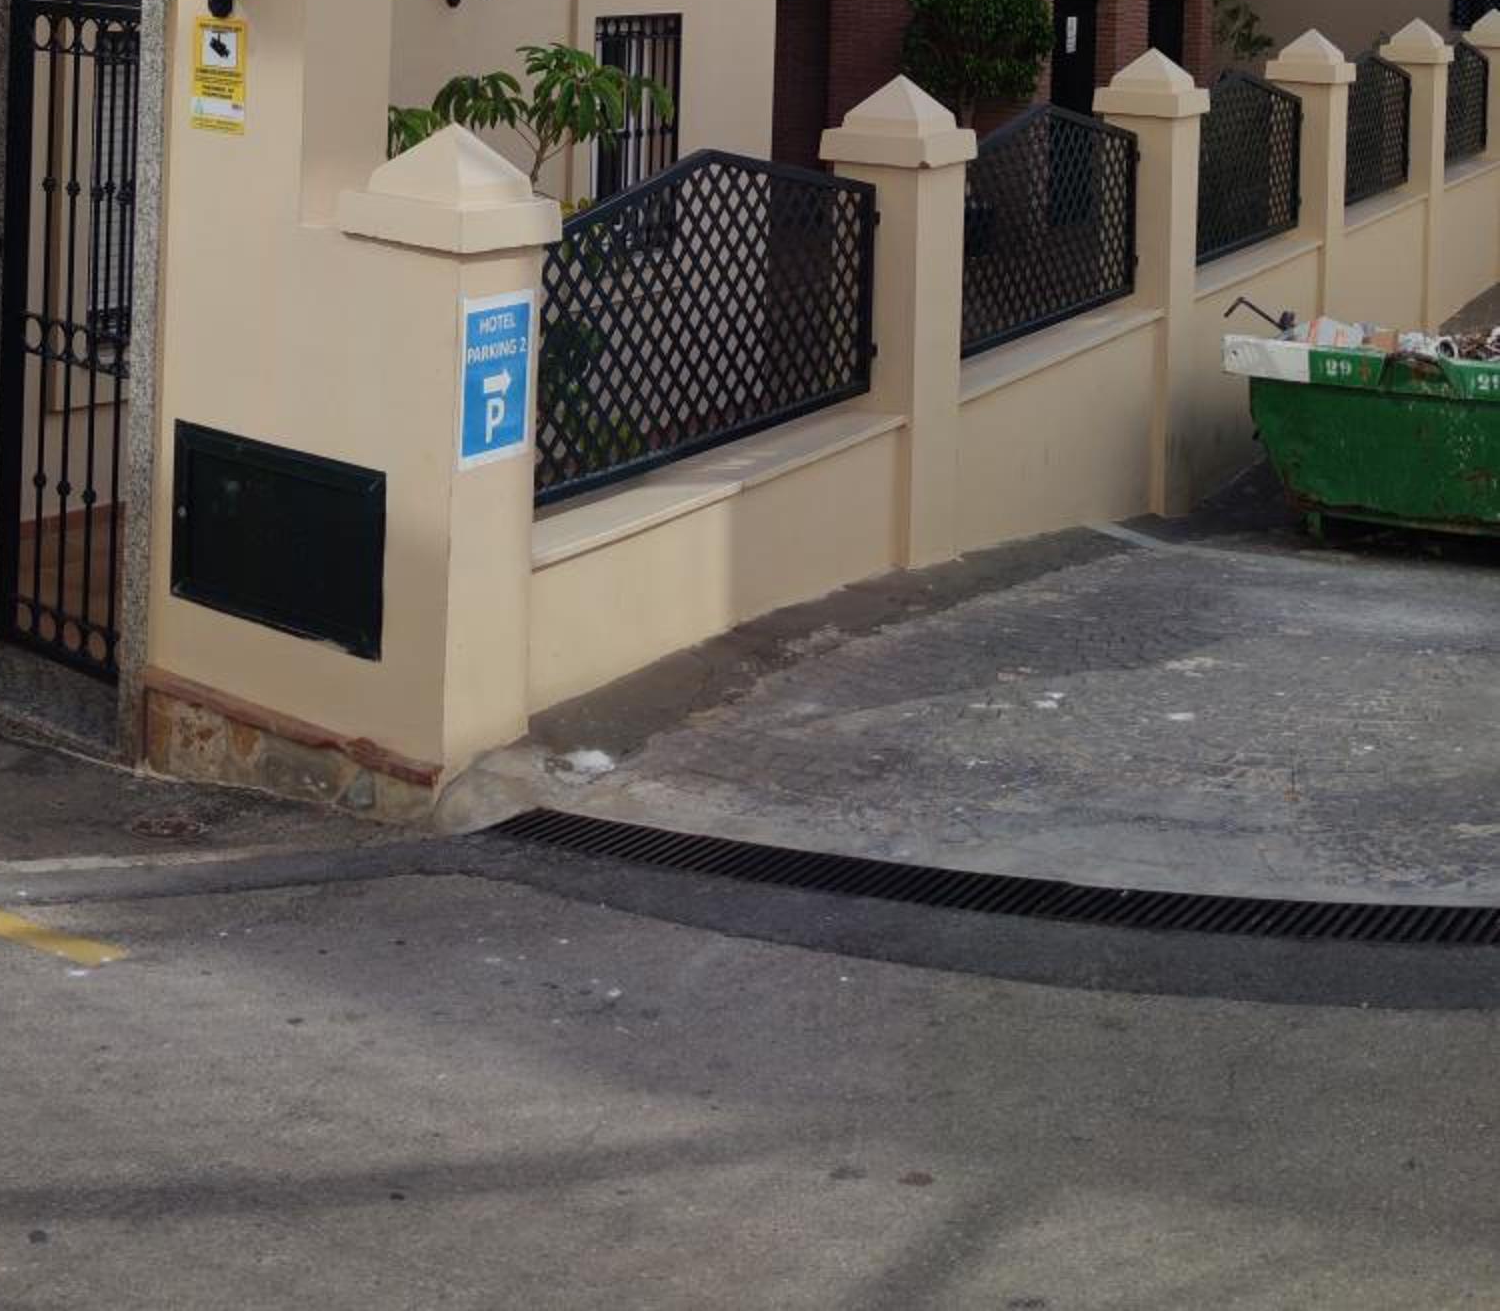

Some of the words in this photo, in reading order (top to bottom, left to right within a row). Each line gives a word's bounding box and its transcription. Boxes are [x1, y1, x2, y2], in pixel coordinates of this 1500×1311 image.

[479, 312, 516, 335] HOTEL
[468, 338, 517, 364] PARKING
[519, 336, 527, 352] 2
[485, 397, 505, 443] P
